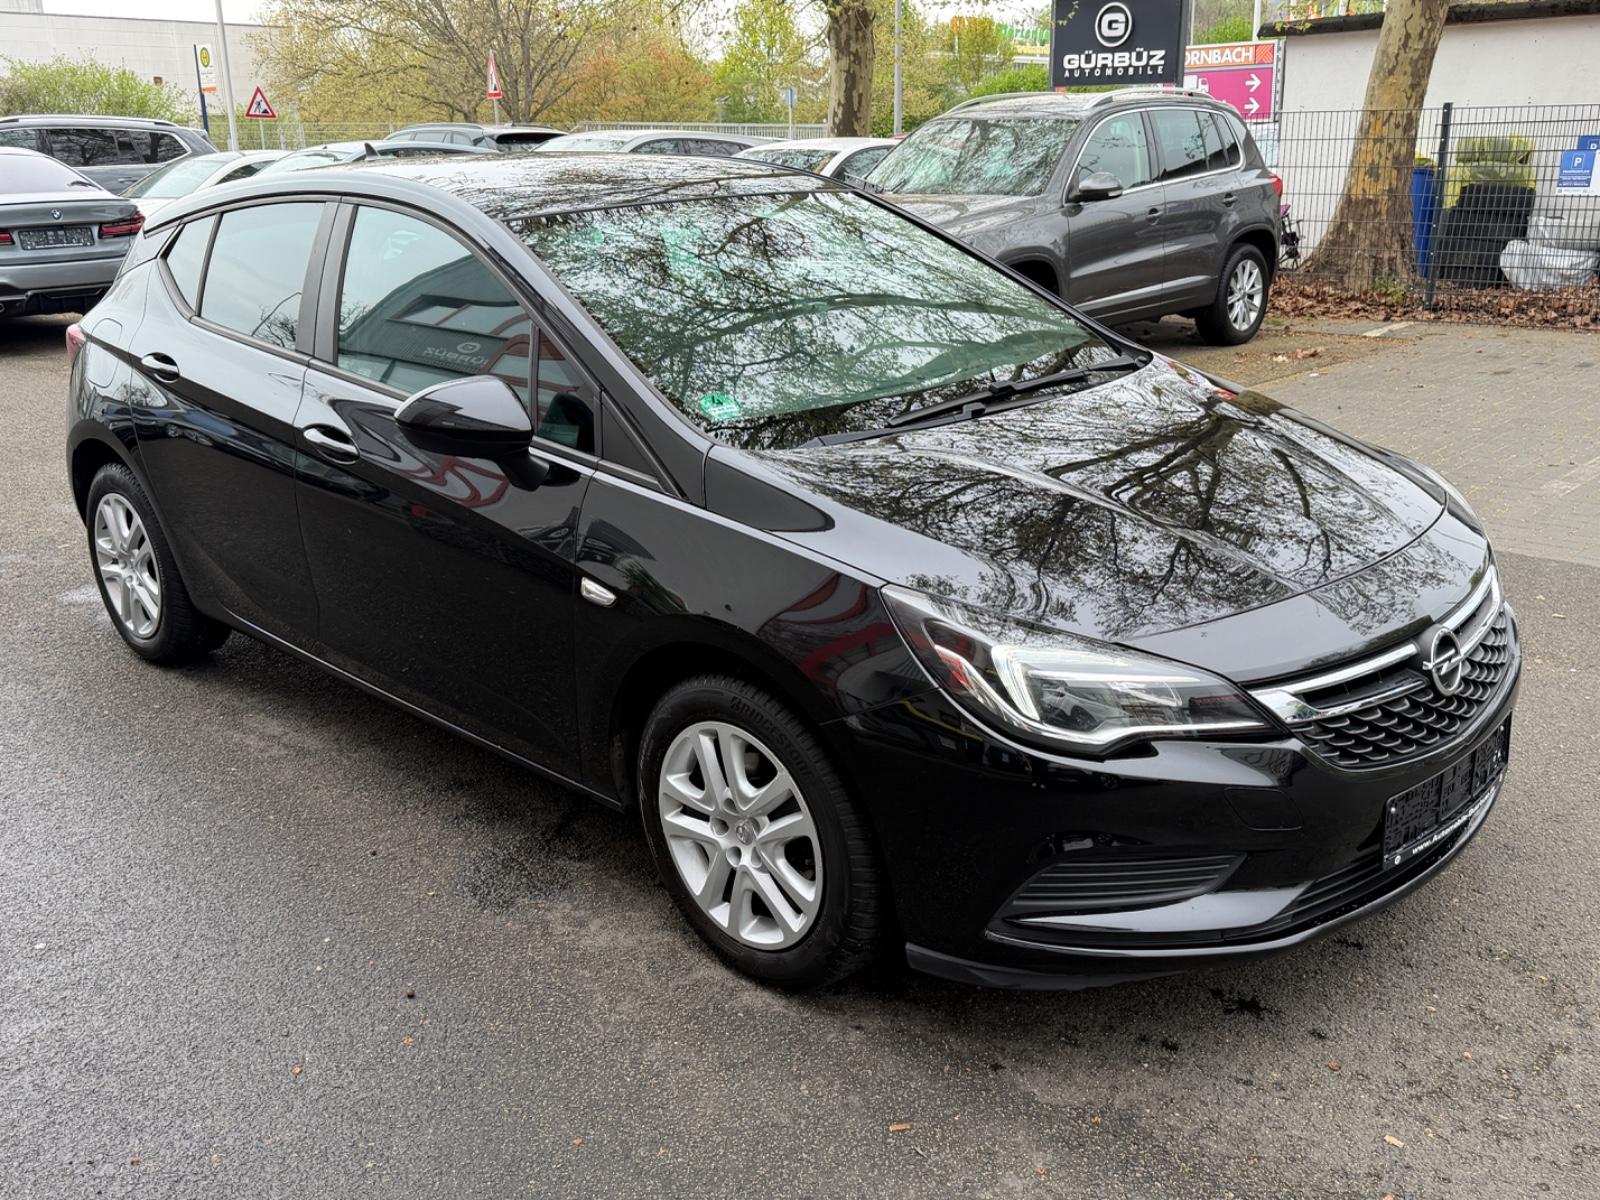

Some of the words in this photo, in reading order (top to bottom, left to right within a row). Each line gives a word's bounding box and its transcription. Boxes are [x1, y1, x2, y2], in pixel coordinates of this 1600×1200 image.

[1101, 13, 1126, 37] G
[1063, 48, 1166, 69] GÜRBÜZ
[1064, 66, 1164, 78] AUTOMOBILE
